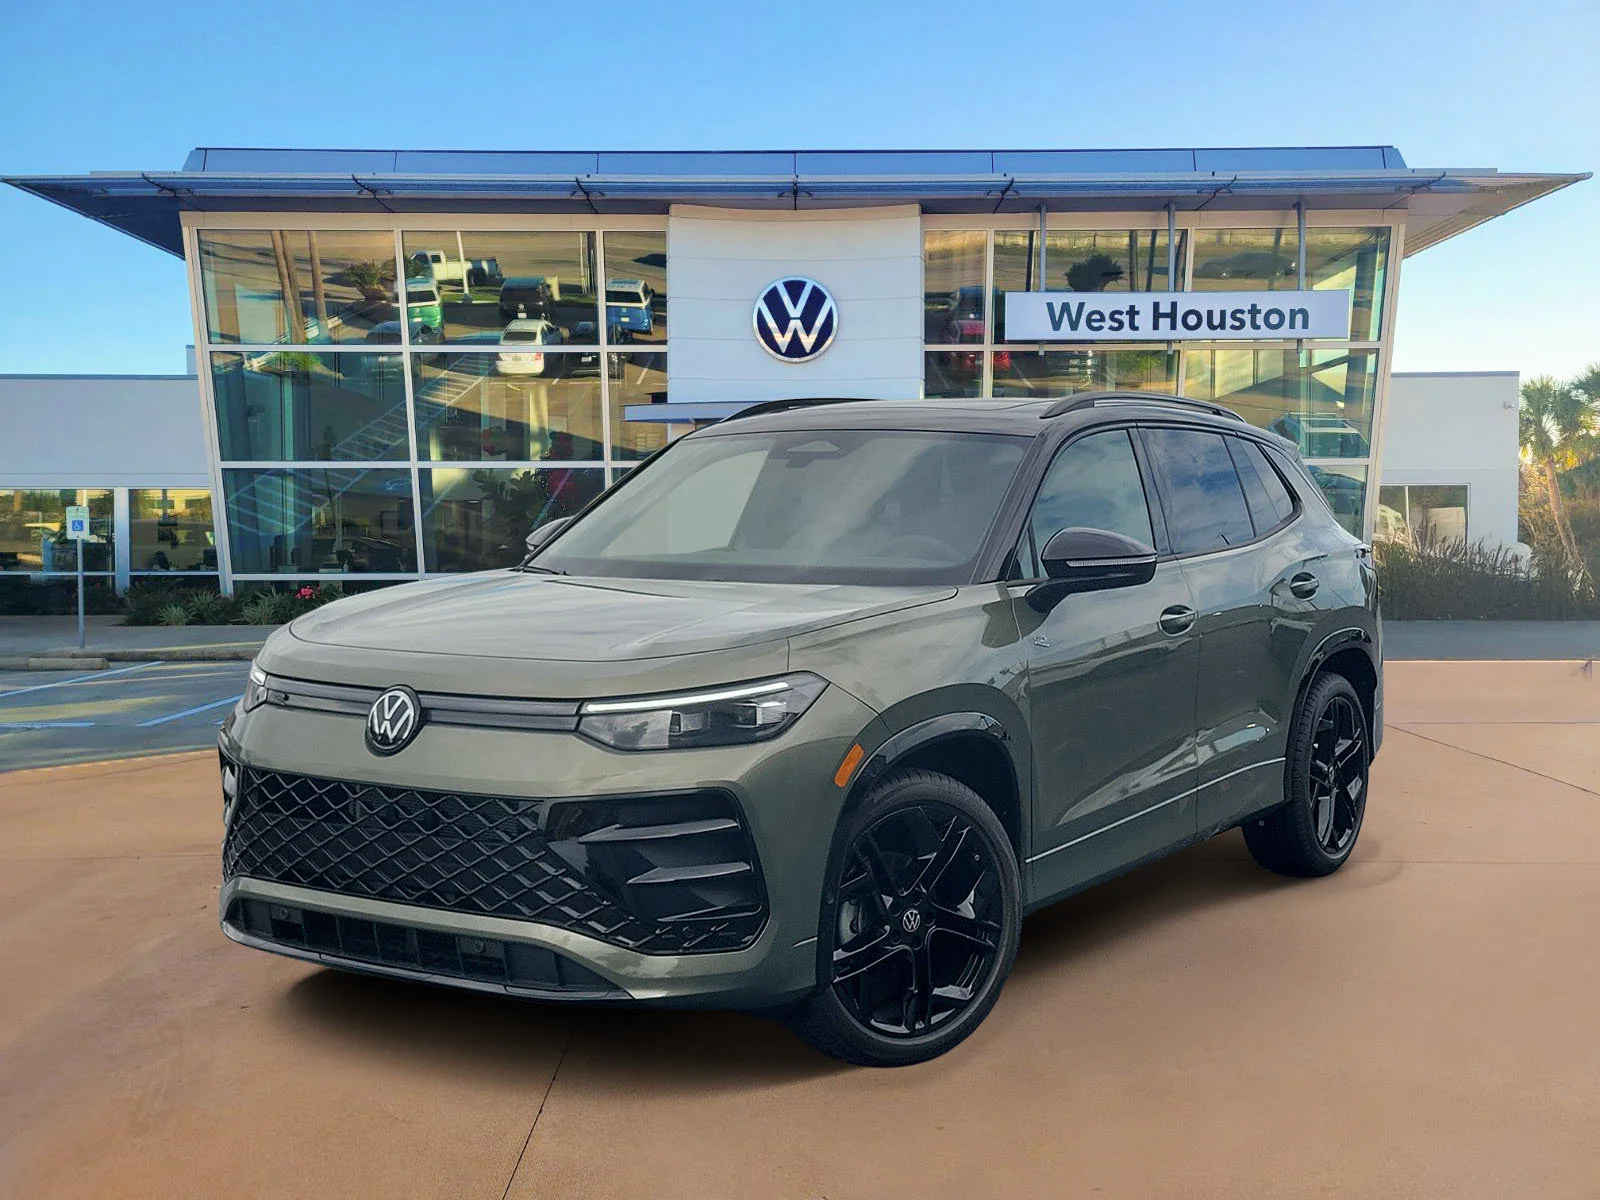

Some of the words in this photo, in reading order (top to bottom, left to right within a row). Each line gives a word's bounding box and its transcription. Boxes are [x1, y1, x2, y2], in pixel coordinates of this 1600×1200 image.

[755, 279, 835, 355] VW
[1046, 301, 1140, 331] West
[1152, 301, 1310, 331] Houston
[370, 691, 413, 745] VW
